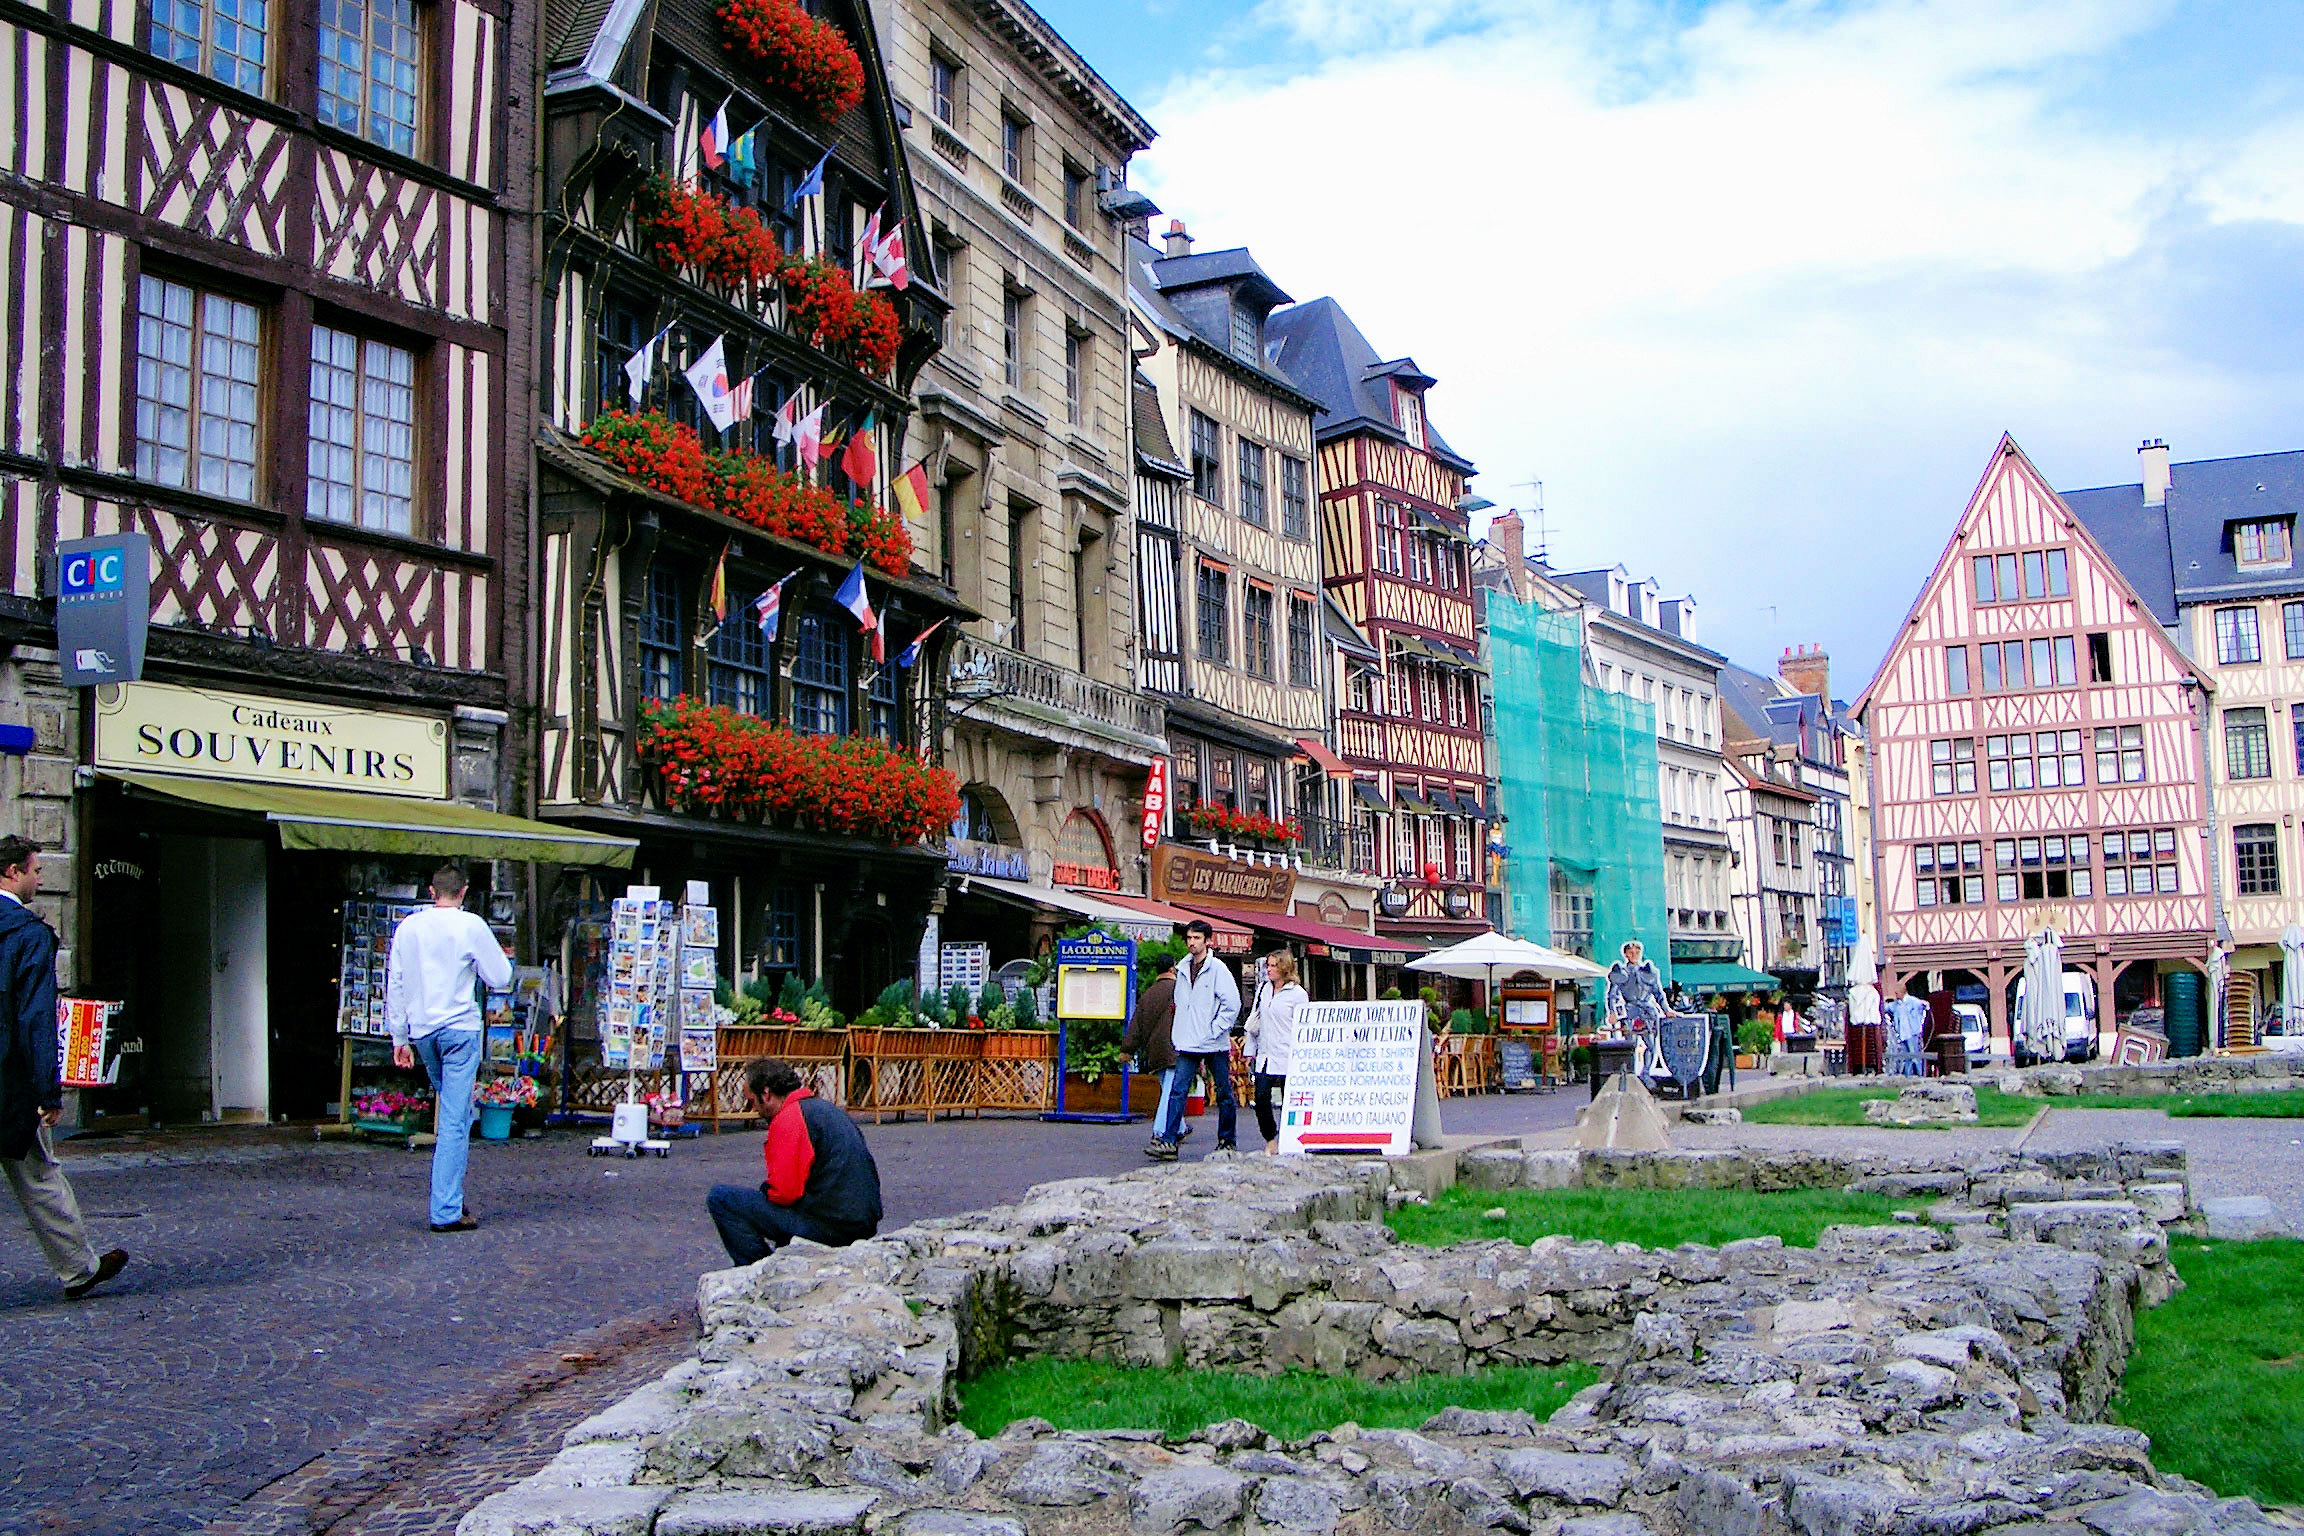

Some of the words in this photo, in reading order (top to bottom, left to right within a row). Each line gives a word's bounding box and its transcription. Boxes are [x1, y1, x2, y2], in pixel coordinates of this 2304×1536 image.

[67, 554, 119, 588] CIC
[232, 705, 333, 736] Cadeaux
[138, 723, 414, 781] SOUVENIRS
[1143, 758, 1164, 845] TABAC
[1192, 867, 1211, 891] LES
[1062, 945, 1074, 955] LA
[1074, 945, 1129, 955] COURONNE
[1299, 1007, 1312, 1024] LE
[1316, 1007, 1362, 1023] TERROIR
[1364, 1005, 1417, 1022] NORMAND
[1297, 1027, 1344, 1043] CADEAUX
[1351, 1025, 1415, 1042] SOUVENIRS
[1289, 1075, 1347, 1087] CONFISERIES
[1349, 1074, 1411, 1086] NORMANDES
[1321, 1091, 1336, 1105] WE
[1337, 1091, 1367, 1105] SPEAK
[1369, 1091, 1409, 1105] ENGLISH
[1316, 1111, 1363, 1125] PARLIAMO
[1365, 1111, 1407, 1125] ITALIANO
